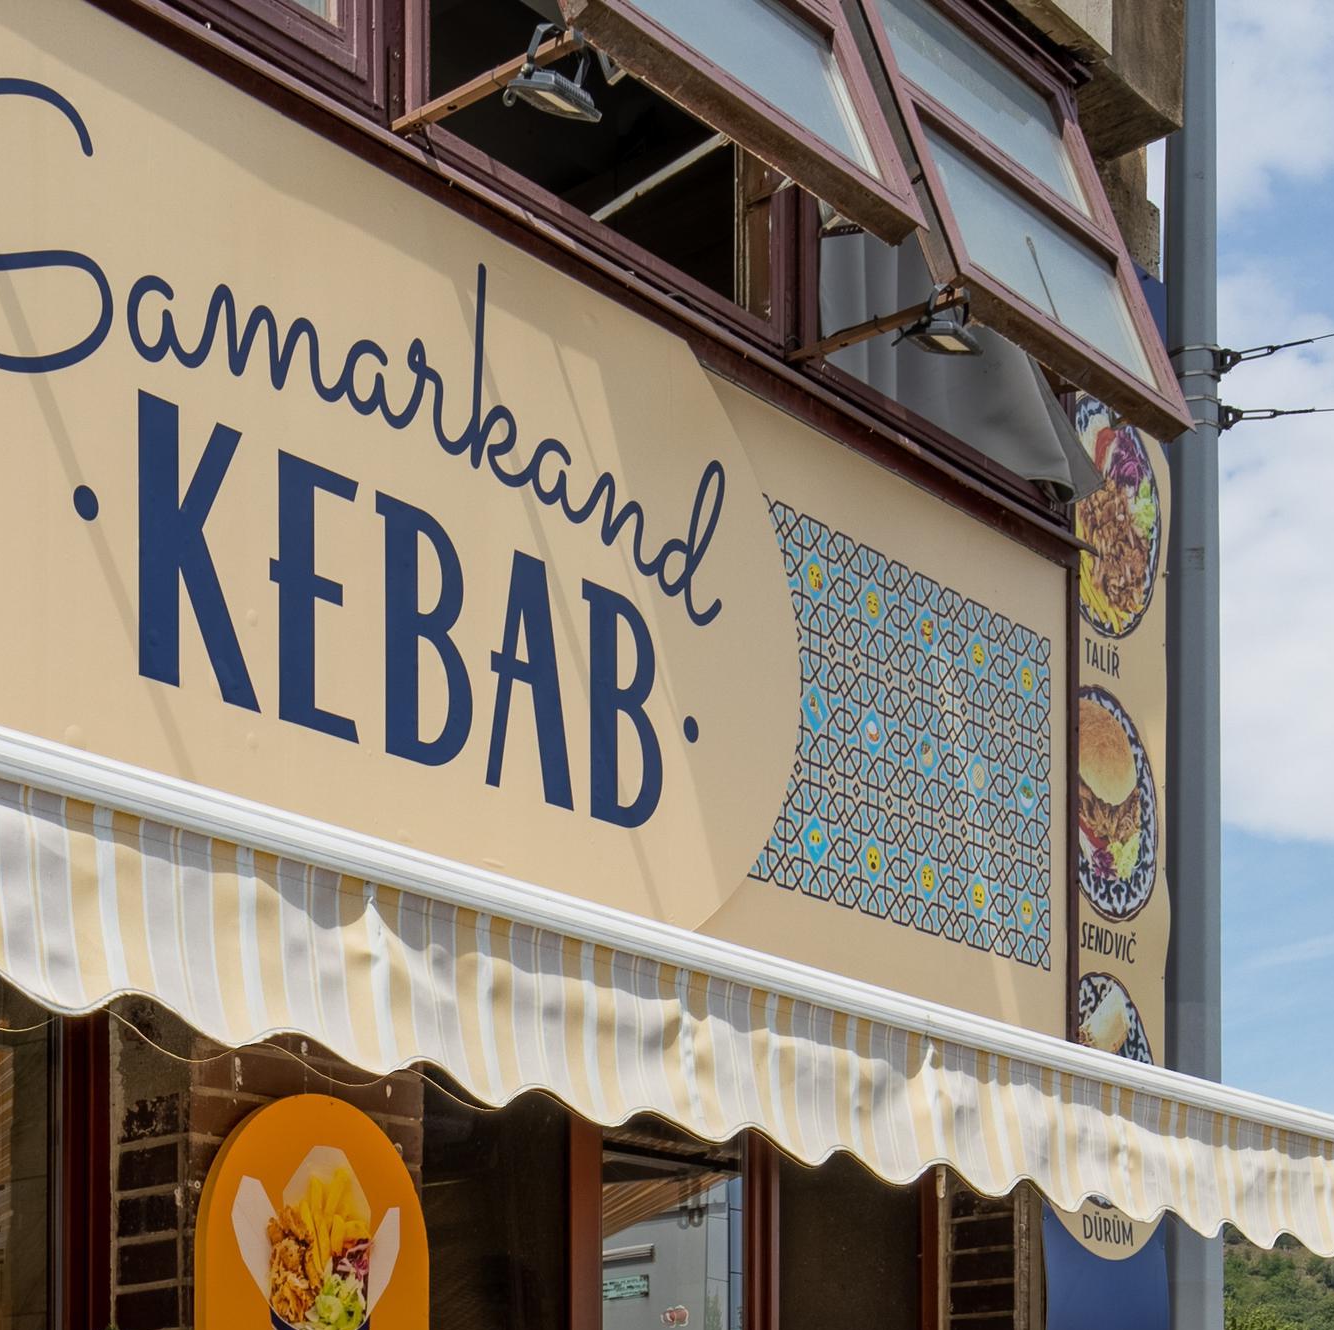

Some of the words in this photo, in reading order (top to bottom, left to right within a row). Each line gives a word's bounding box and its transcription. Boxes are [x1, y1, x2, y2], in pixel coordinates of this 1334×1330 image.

[137, 388, 665, 829] KEBAB
[1084, 636, 1121, 680] TALÍŘ
[1080, 921, 1137, 964] SENDVIČ
[1082, 1210, 1135, 1248] DÜRÜM
